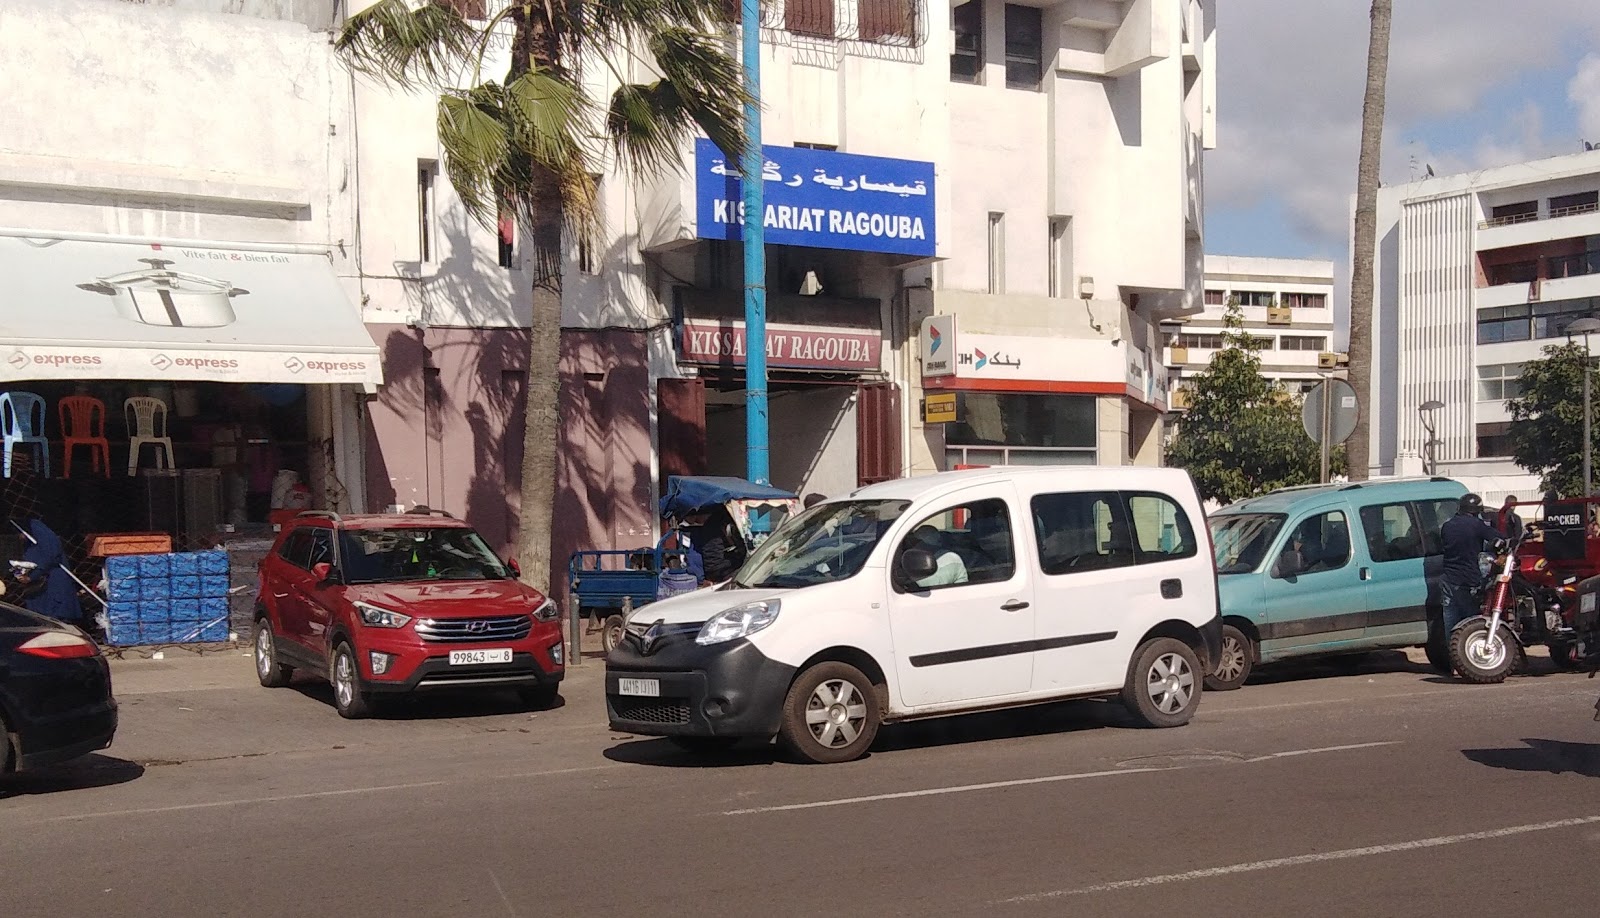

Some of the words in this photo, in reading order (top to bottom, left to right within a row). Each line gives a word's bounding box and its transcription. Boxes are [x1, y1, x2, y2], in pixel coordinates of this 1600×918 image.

[813, 169, 927, 197] قيسارية
[713, 199, 825, 232] KISARIAT
[829, 209, 926, 240] RAGOUBA
[181, 249, 206, 259] Vite
[208, 251, 228, 260] fait
[230, 253, 241, 261] &
[244, 253, 269, 263] bien
[270, 255, 290, 264] fait
[691, 330, 787, 358] KISSAAT
[790, 336, 871, 362] RAGOUBA
[33, 354, 102, 368] express
[175, 357, 239, 369] express
[957, 353, 973, 365] IH
[306, 360, 366, 374] express
[453, 651, 486, 664] 99843
[503, 650, 510, 661] 8
